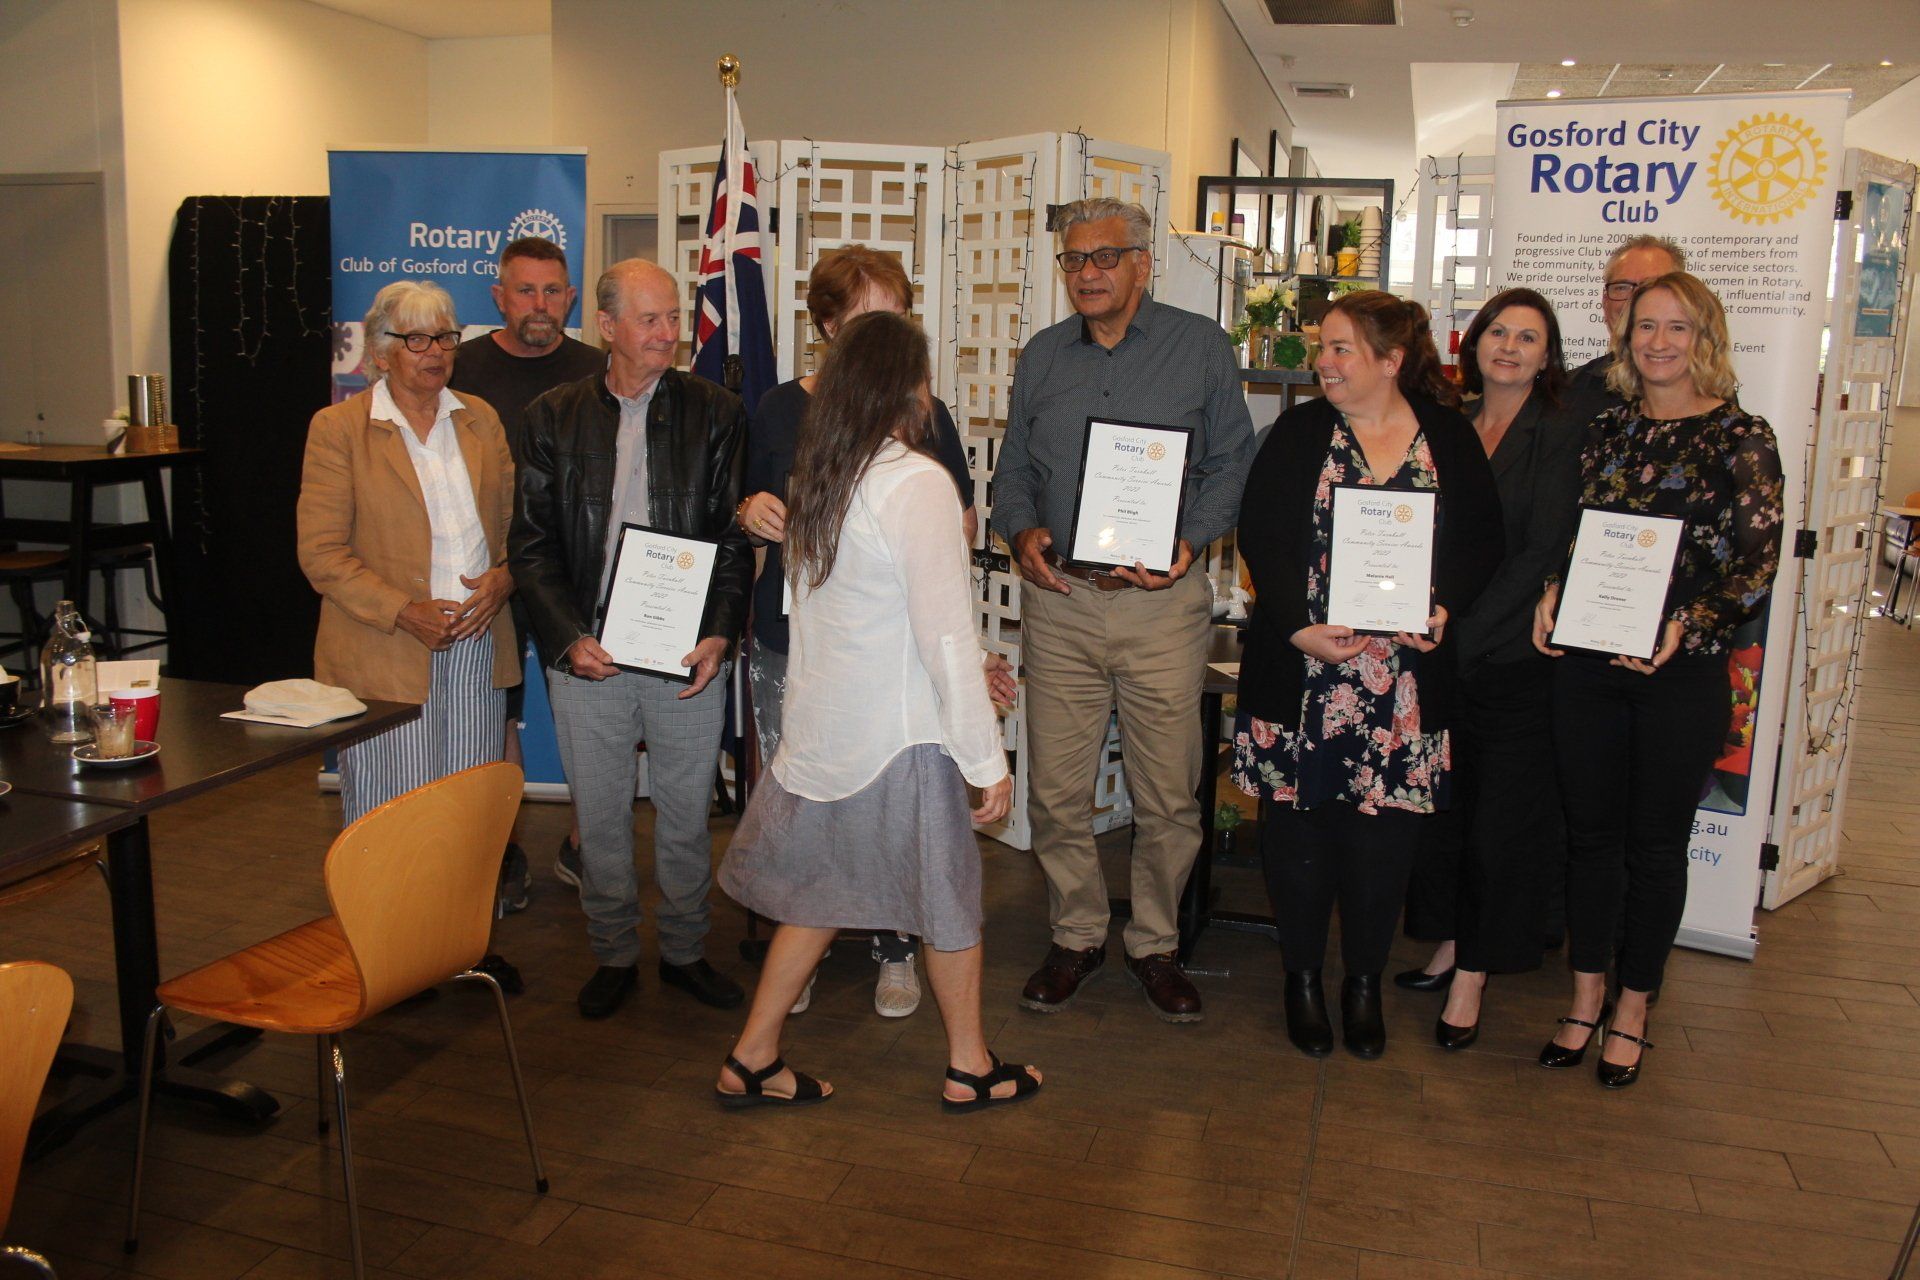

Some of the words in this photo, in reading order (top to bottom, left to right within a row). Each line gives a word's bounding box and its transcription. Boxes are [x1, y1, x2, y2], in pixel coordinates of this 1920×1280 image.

[1507, 118, 1626, 149] Gosford
[1637, 116, 1700, 152] City
[1744, 125, 1795, 139] ROTARY
[1529, 153, 1698, 205] Rotary
[1601, 200, 1660, 224] Club
[409, 222, 502, 255] Rotary
[1517, 233, 1563, 243] Founded
[1566, 233, 1576, 243] in
[1578, 234, 1603, 244] June
[1681, 236, 1688, 245] a
[1690, 235, 1773, 249] contemporary
[1775, 235, 1799, 245] and
[1514, 246, 1575, 258] progressive
[1578, 246, 1602, 256] Club
[1696, 248, 1708, 258] of
[1711, 248, 1766, 259] members
[1769, 249, 1798, 259] from
[340, 256, 374, 273] Club
[379, 257, 397, 273] of
[402, 257, 468, 276] Gosford
[472, 259, 500, 280] City
[1512, 259, 1530, 269] the
[1532, 260, 1595, 272] community,
[1709, 262, 1749, 273] service
[1752, 263, 1798, 273] sectors.
[1506, 272, 1523, 282] We
[1525, 272, 1553, 284] pride
[1556, 272, 1605, 283] ourselves
[1702, 277, 1744, 287] women
[1748, 276, 1759, 286] in
[1762, 276, 1804, 288] Rotary.
[1536, 286, 1585, 297] ourselves
[1587, 287, 1599, 297] as
[1726, 290, 1785, 301] influential
[1788, 291, 1811, 302] and
[1556, 300, 1579, 310] part
[1581, 299, 1594, 309] of
[1736, 304, 1807, 318] community.
[1733, 342, 1766, 353] Event
[1114, 442, 1145, 454] Rotary
[1357, 499, 1381, 507] Gosford
[1381, 500, 1393, 508] City
[1360, 506, 1392, 517] Rotary
[1378, 518, 1393, 526] Club
[1603, 529, 1635, 541] Rotary
[645, 549, 675, 563] Rotary
[660, 562, 674, 570] Club
